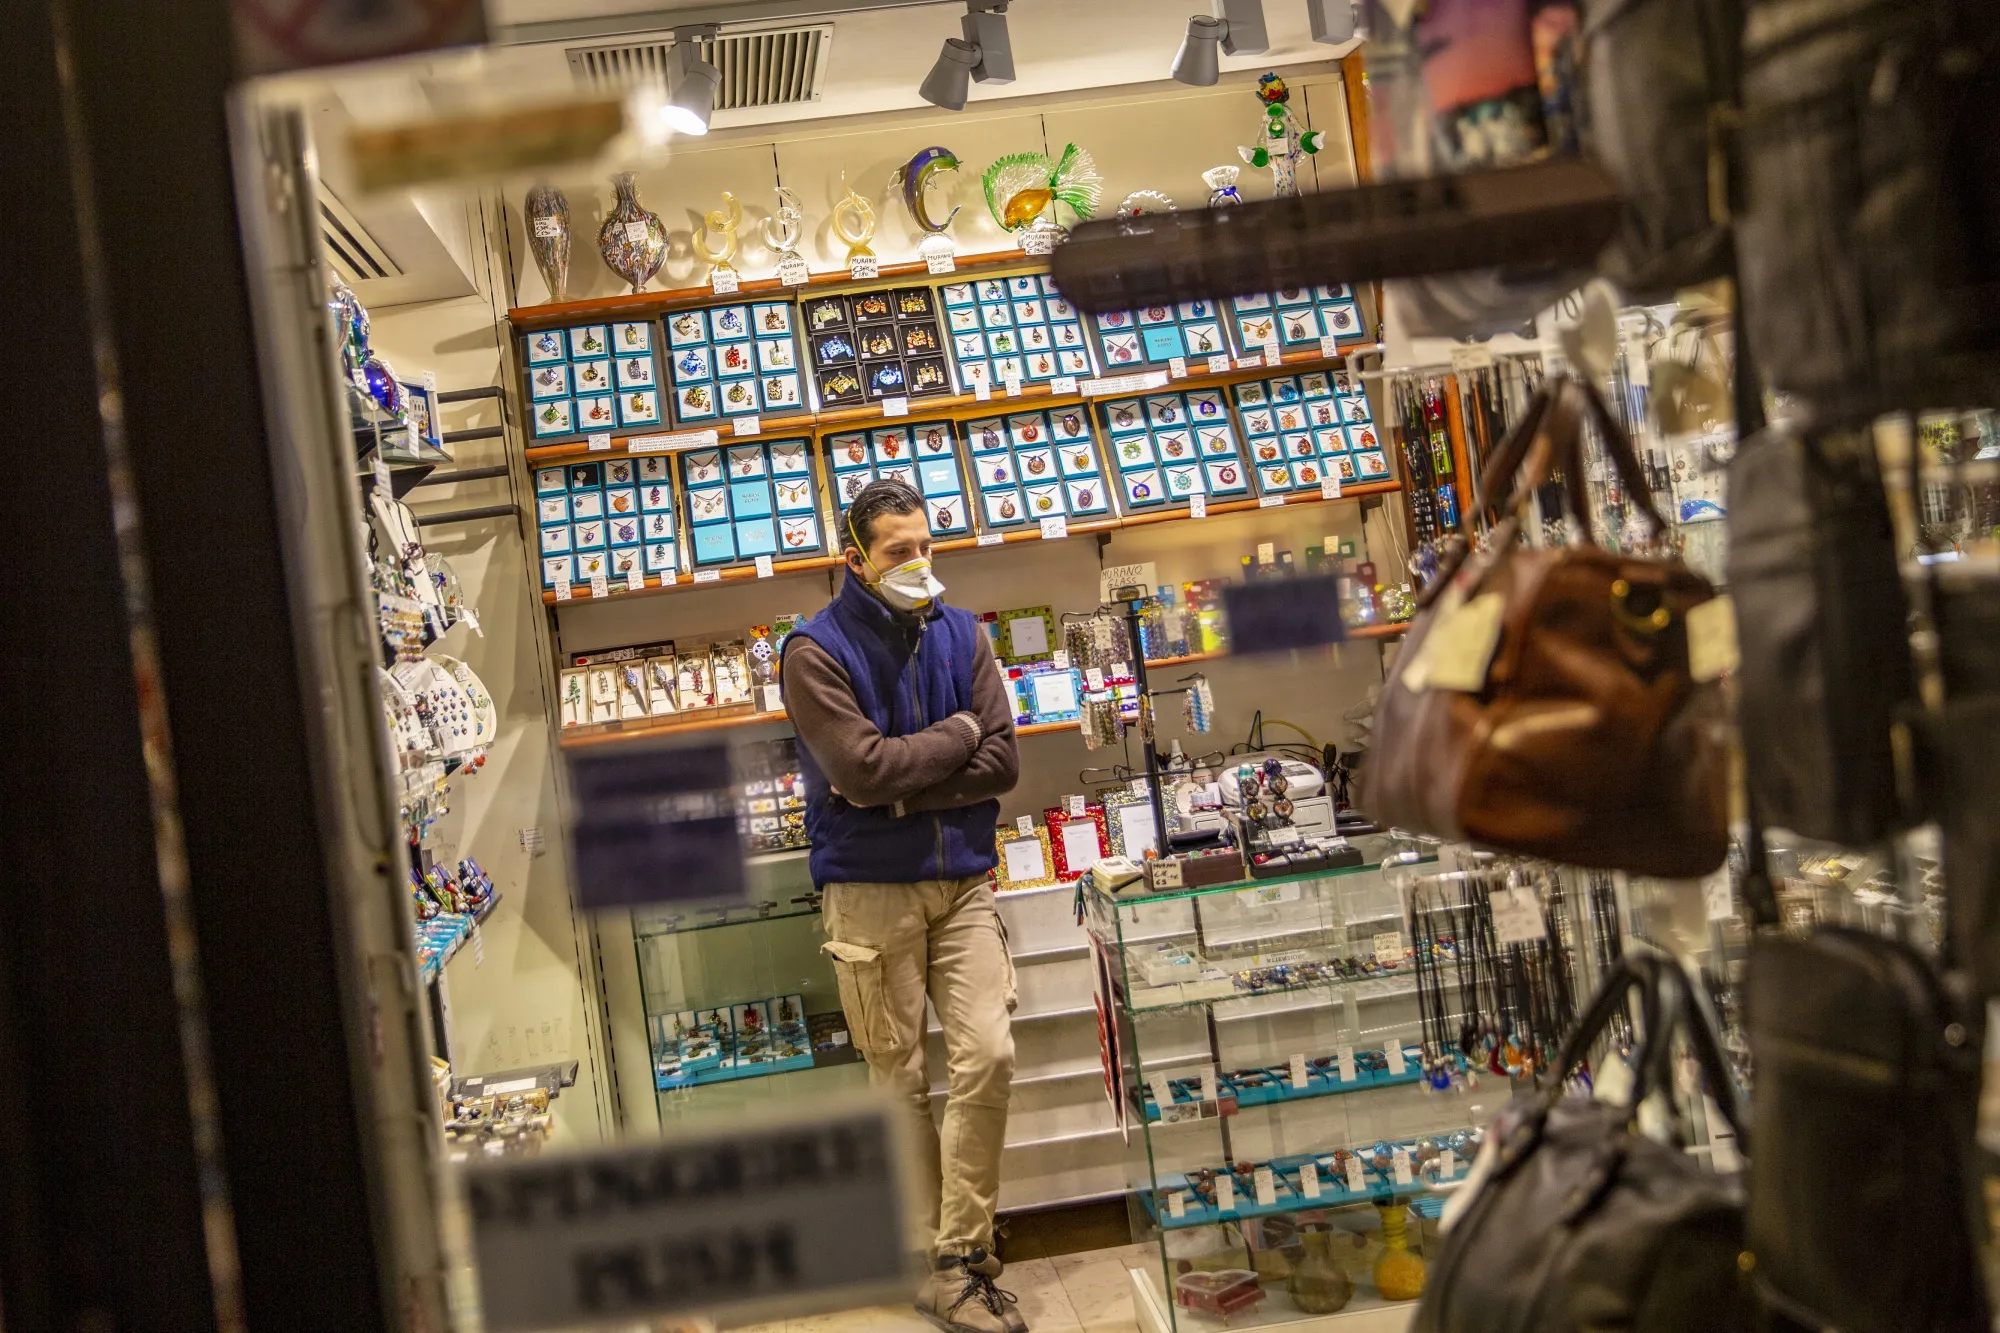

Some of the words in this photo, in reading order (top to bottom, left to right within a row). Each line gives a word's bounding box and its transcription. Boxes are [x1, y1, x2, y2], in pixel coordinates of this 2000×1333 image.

[852, 256, 876, 265] MURANO
[927, 253, 951, 261] MURANO
[781, 262, 804, 271] MURANO
[1101, 565, 1142, 580] MURANO
[1107, 577, 1137, 588] GLASS
